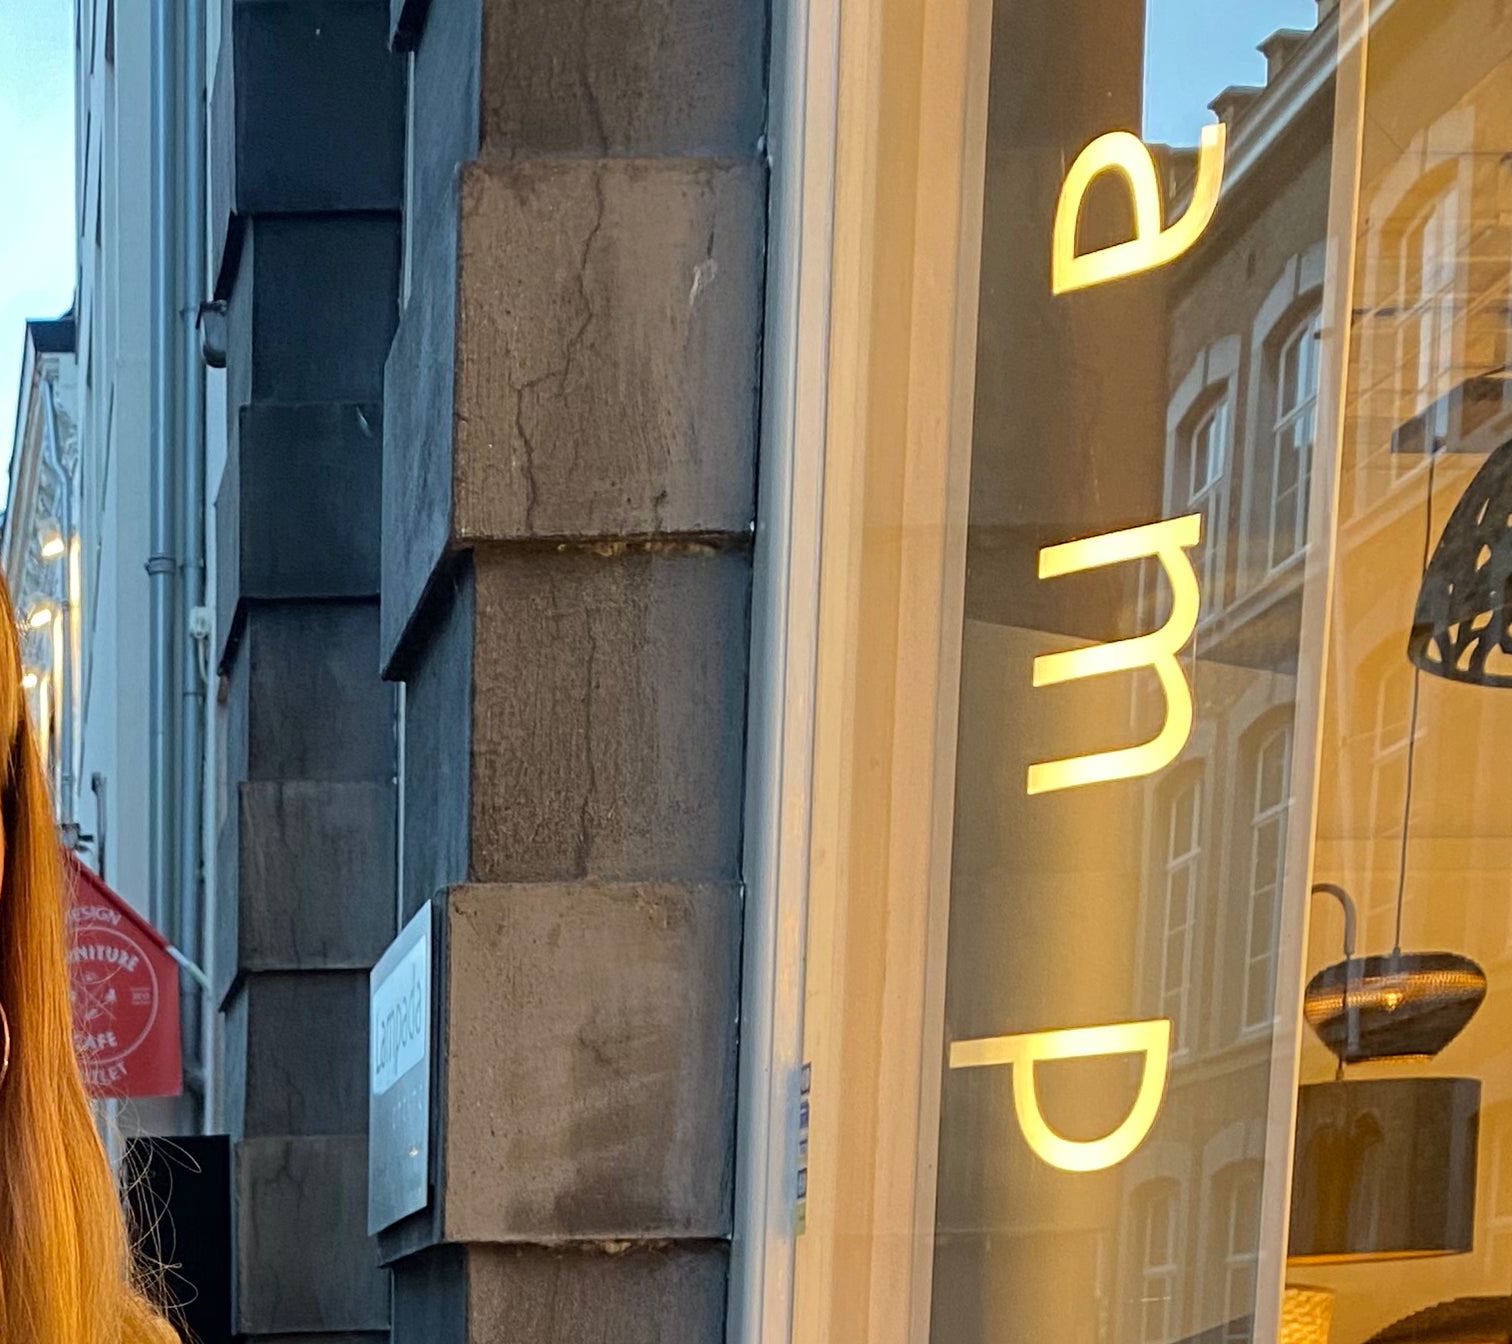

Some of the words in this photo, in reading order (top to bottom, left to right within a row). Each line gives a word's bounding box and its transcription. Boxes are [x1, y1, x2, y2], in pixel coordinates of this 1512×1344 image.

[70, 905, 122, 926] ESIGN
[71, 945, 139, 972] NITURE
[375, 962, 423, 1075] Lampada
[88, 1060, 127, 1085] TLET
